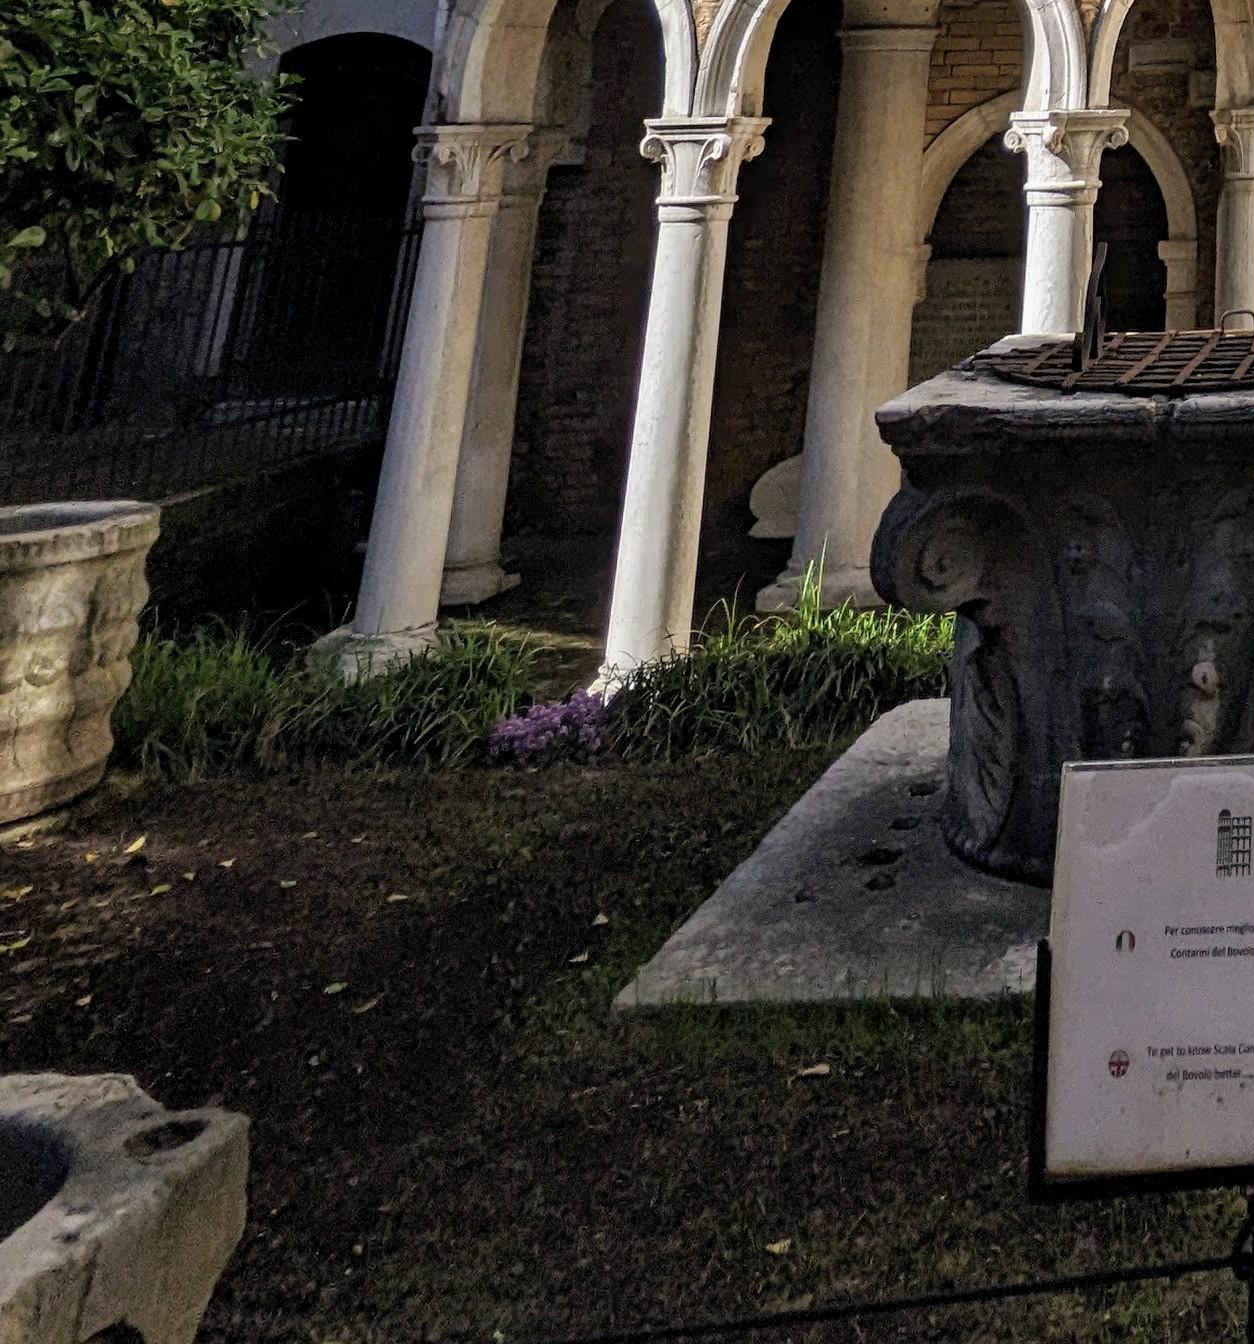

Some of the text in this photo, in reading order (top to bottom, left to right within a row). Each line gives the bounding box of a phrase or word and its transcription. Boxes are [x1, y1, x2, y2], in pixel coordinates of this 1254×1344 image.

[1164, 925, 1179, 936] Per
[1180, 925, 1225, 936] conoscere
[1170, 947, 1210, 959] Contarini
[1211, 946, 1226, 958] del
[1146, 1045, 1159, 1057] To
[1159, 1046, 1175, 1061] get
[1176, 1045, 1186, 1056] to
[1187, 1045, 1212, 1056] know
[1213, 1043, 1236, 1055] Scala
[1166, 1069, 1180, 1081] del
